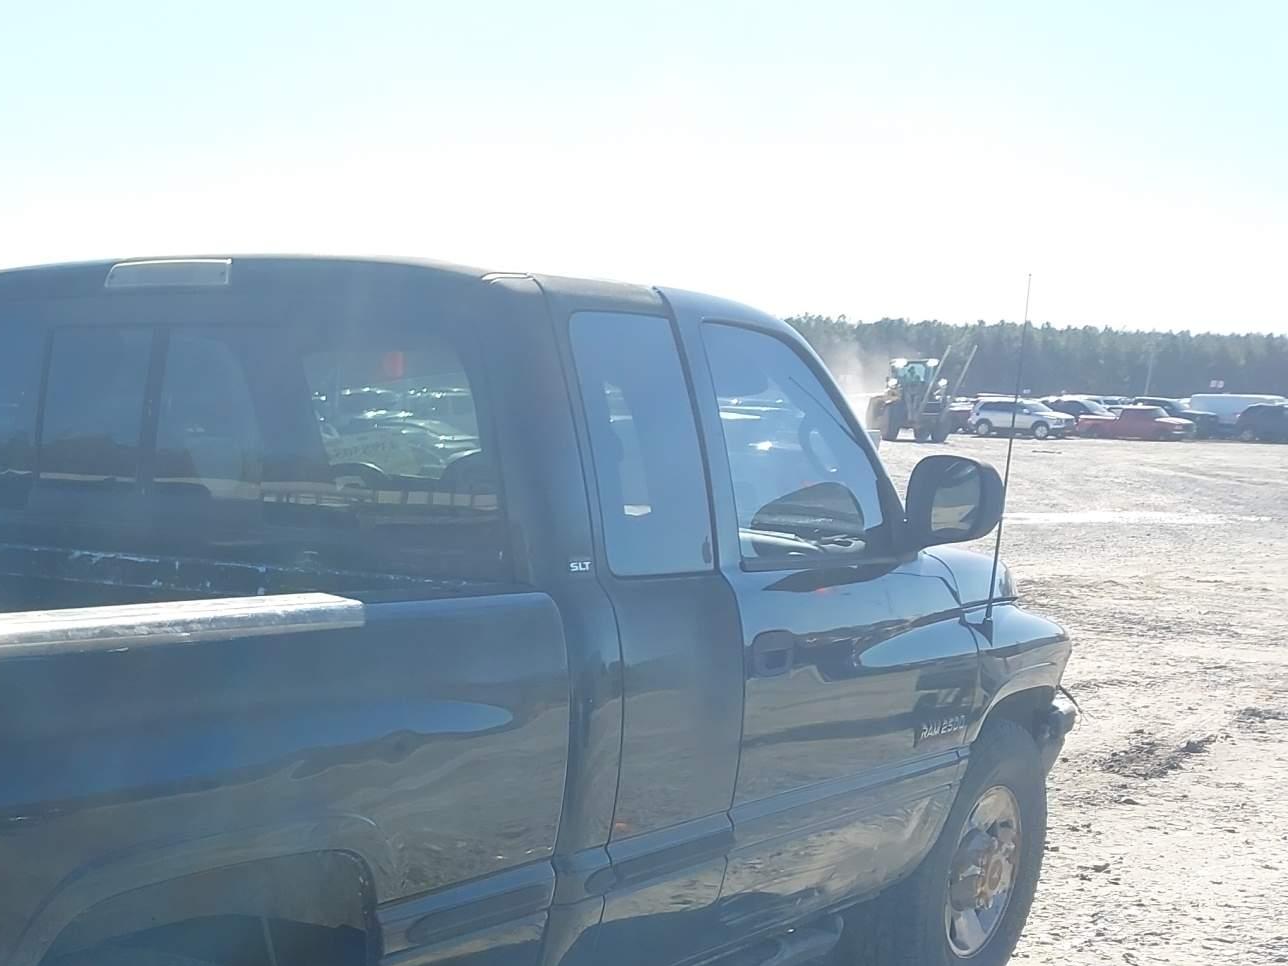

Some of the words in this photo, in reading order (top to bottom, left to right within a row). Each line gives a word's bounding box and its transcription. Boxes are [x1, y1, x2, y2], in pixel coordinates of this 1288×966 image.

[569, 561, 592, 572] SLT
[920, 720, 942, 739] RAM
[941, 714, 966, 734] 2500
